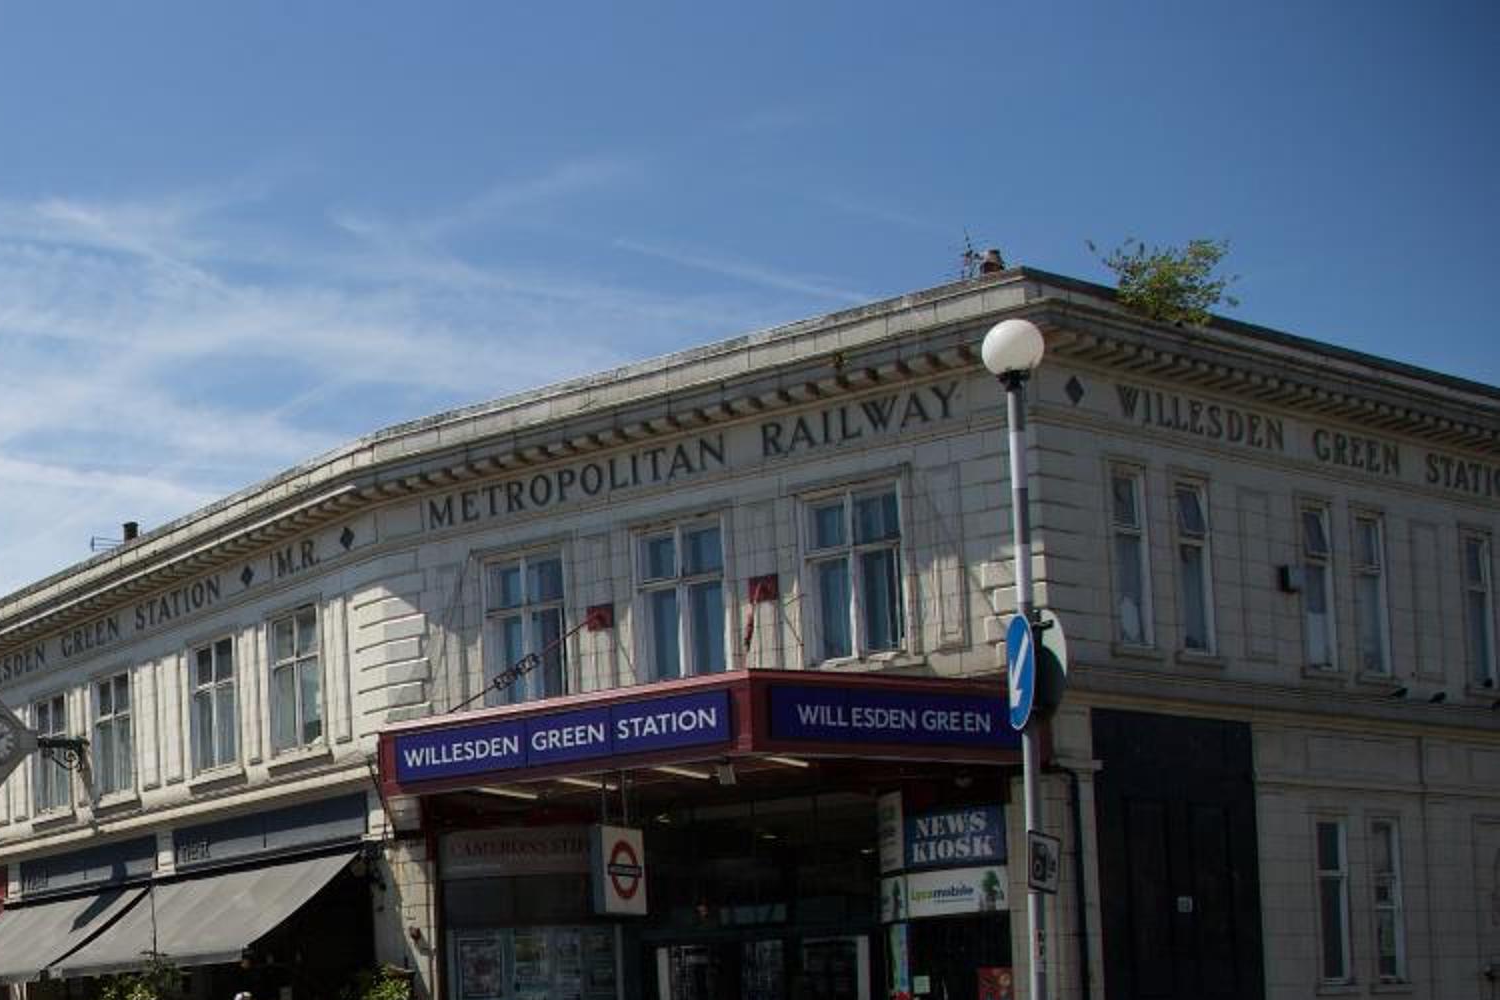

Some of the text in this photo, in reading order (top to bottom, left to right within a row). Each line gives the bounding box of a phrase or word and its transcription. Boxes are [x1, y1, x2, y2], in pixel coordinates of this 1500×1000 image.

[429, 380, 959, 530] METROPOLITAN RAILWAY
[1115, 383, 1284, 449] WILLESDEN
[1313, 428, 1400, 477] GREEN
[277, 539, 320, 578] M.R.
[61, 616, 120, 658] GREEN
[135, 575, 221, 631] STATION
[404, 707, 717, 768] WILLESDEN GREEN STATION
[797, 703, 991, 733] WILLESDEN GREEN
[911, 835, 997, 863] KIOSK
[915, 810, 988, 840] NEWS
